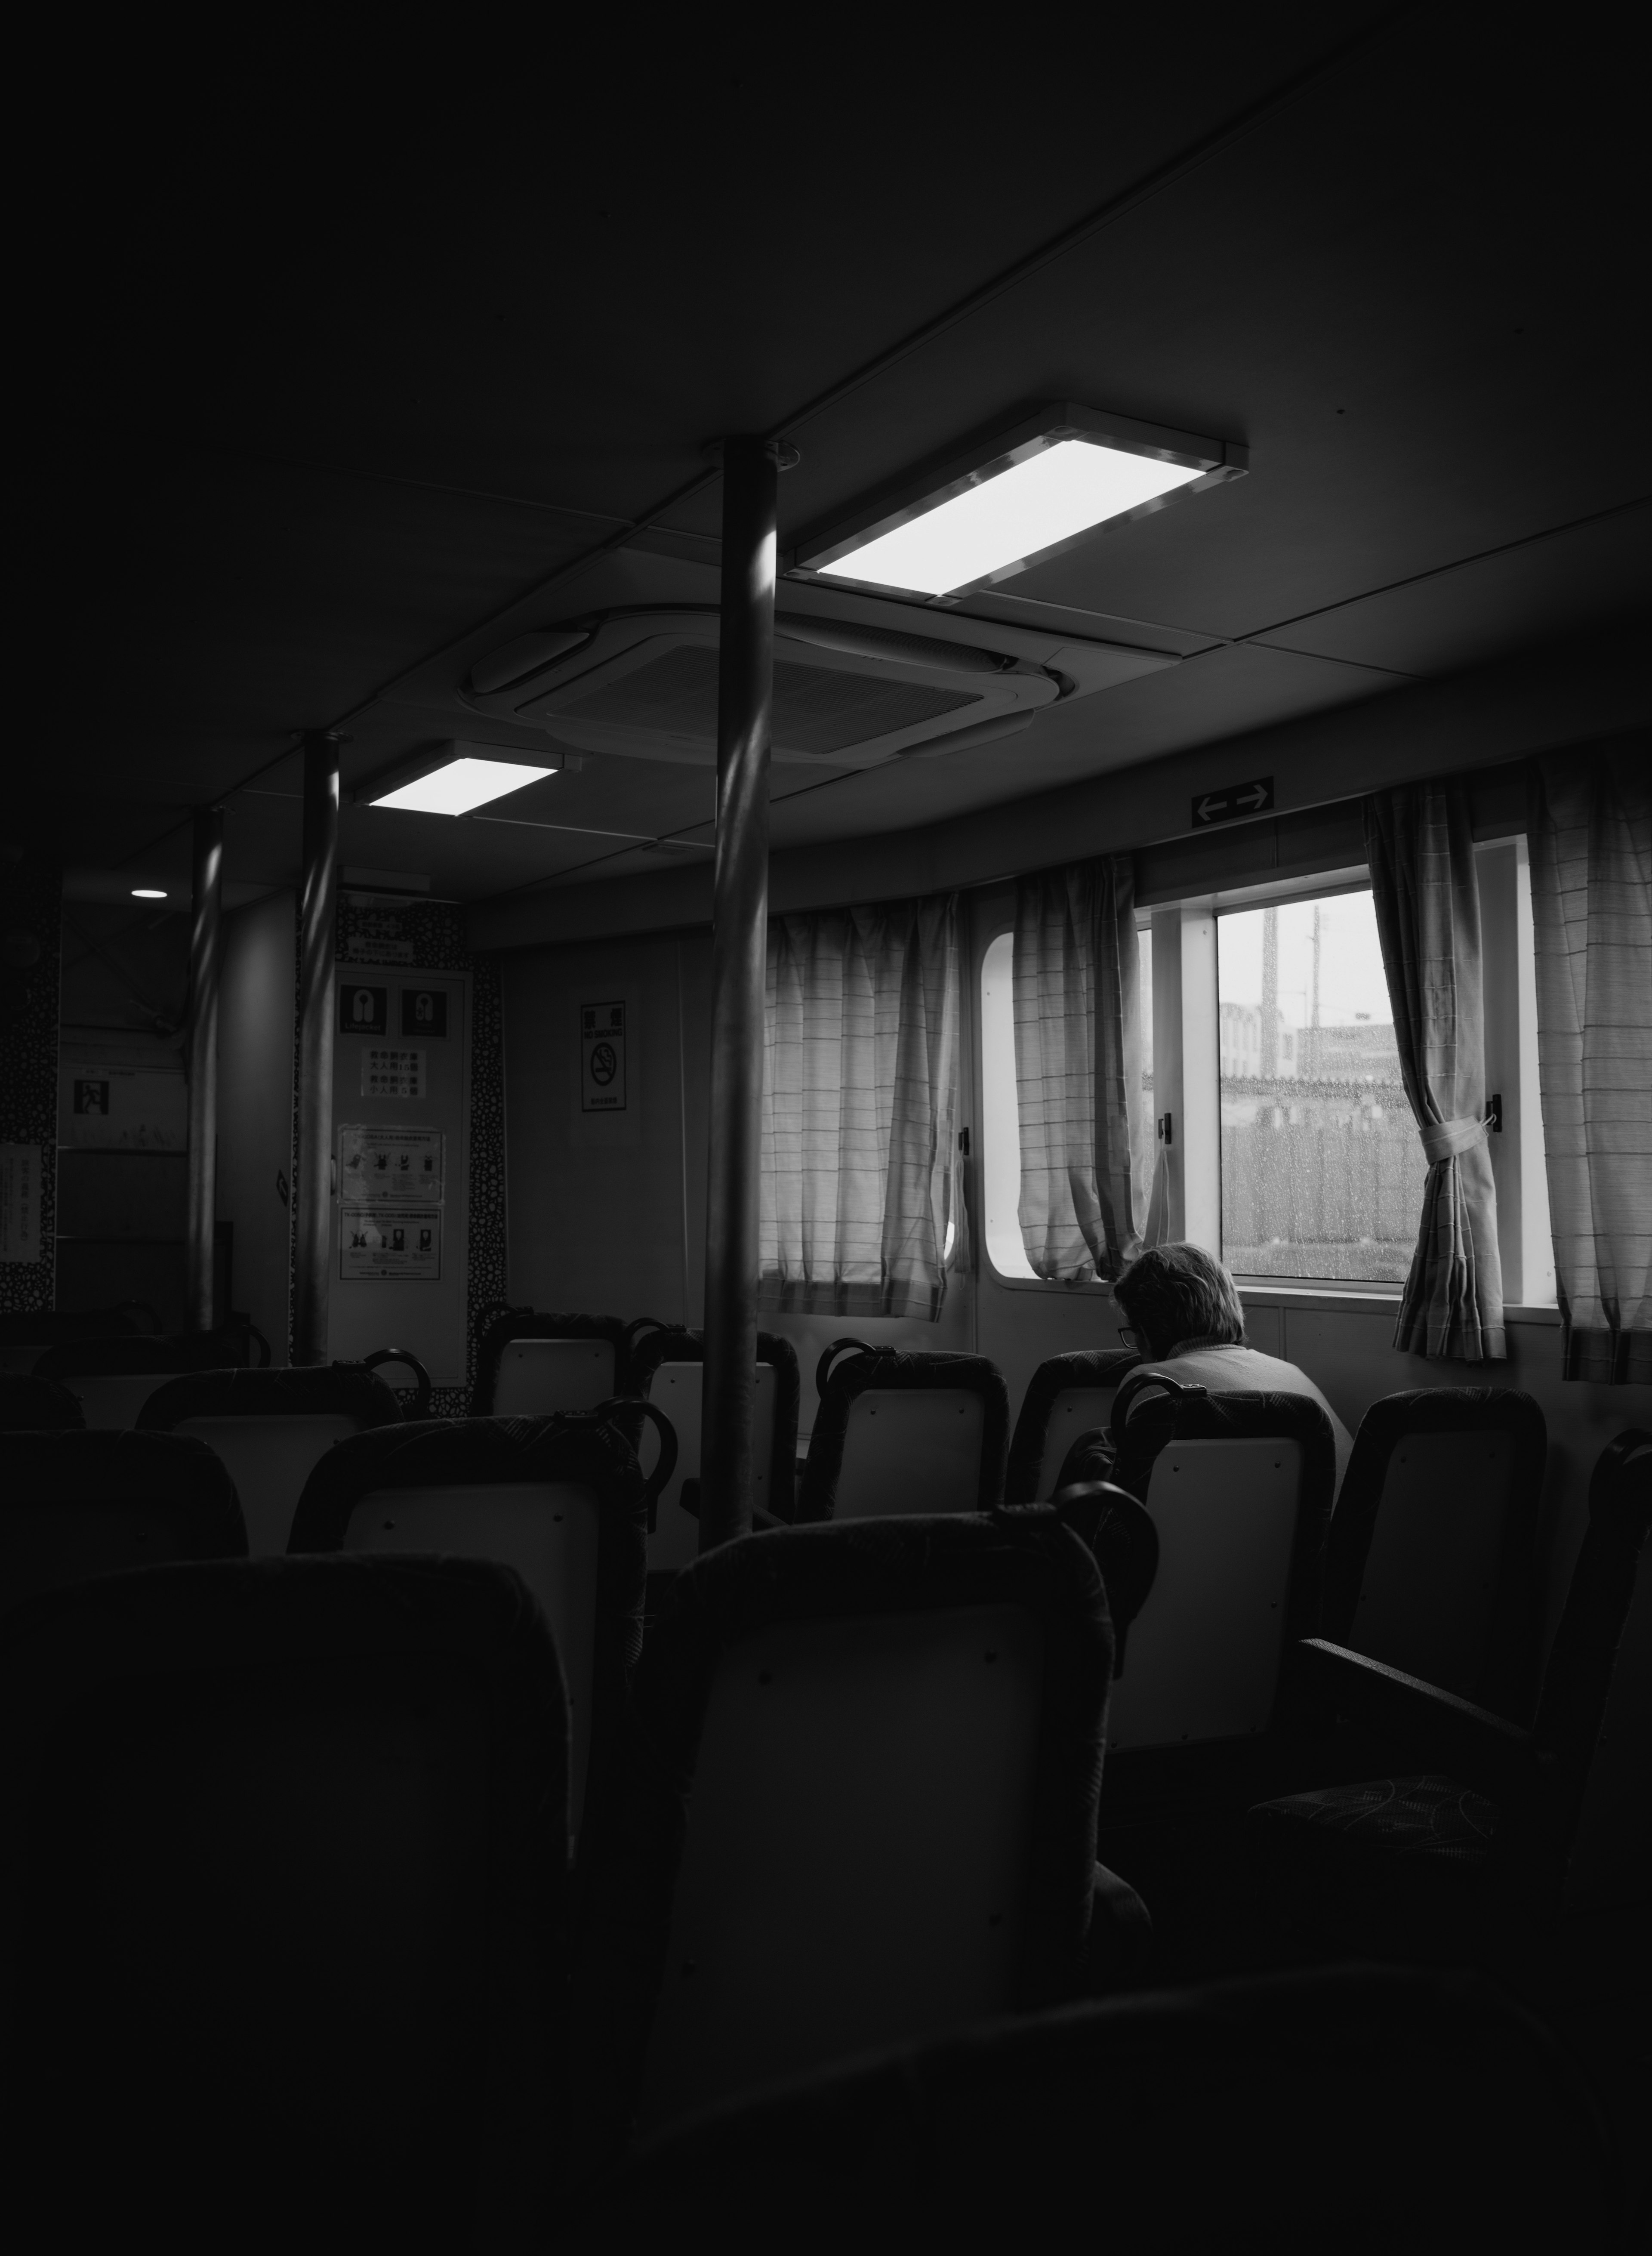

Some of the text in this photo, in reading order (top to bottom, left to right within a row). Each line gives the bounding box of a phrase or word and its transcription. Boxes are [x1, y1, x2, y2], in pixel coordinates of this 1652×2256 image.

[353, 948, 408, 958] 椅子の下にあります
[584, 1008, 622, 1029] 禁煙
[345, 1022, 381, 1031] Lifejacket
[584, 1028, 622, 1039] NO SMOKING
[370, 1050, 417, 1060] 救命胴衣庫
[370, 1075, 417, 1084] 救命胴衣庫
